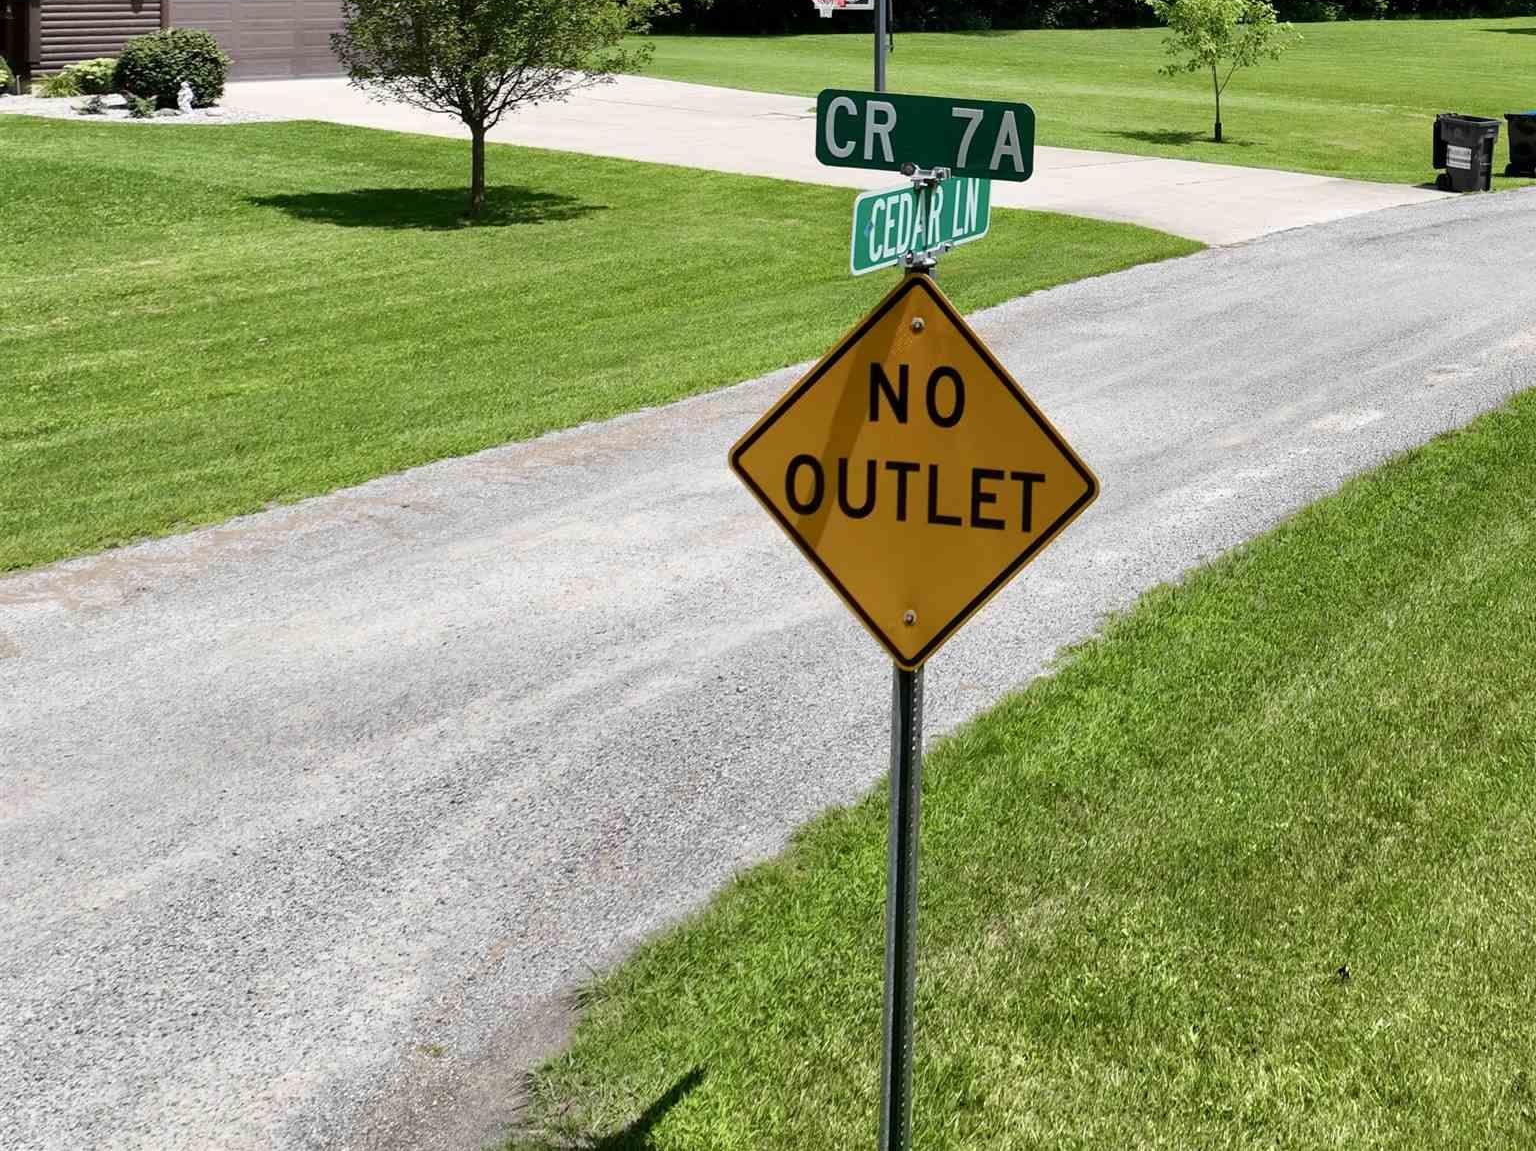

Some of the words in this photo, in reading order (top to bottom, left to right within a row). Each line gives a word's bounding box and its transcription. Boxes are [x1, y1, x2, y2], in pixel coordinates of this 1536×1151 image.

[825, 96, 897, 162] CR
[952, 107, 1025, 173] 7A
[868, 186, 943, 262] CEDAR
[951, 177, 980, 238] LN
[869, 363, 965, 429] NO
[785, 454, 1045, 533] OUTLET
